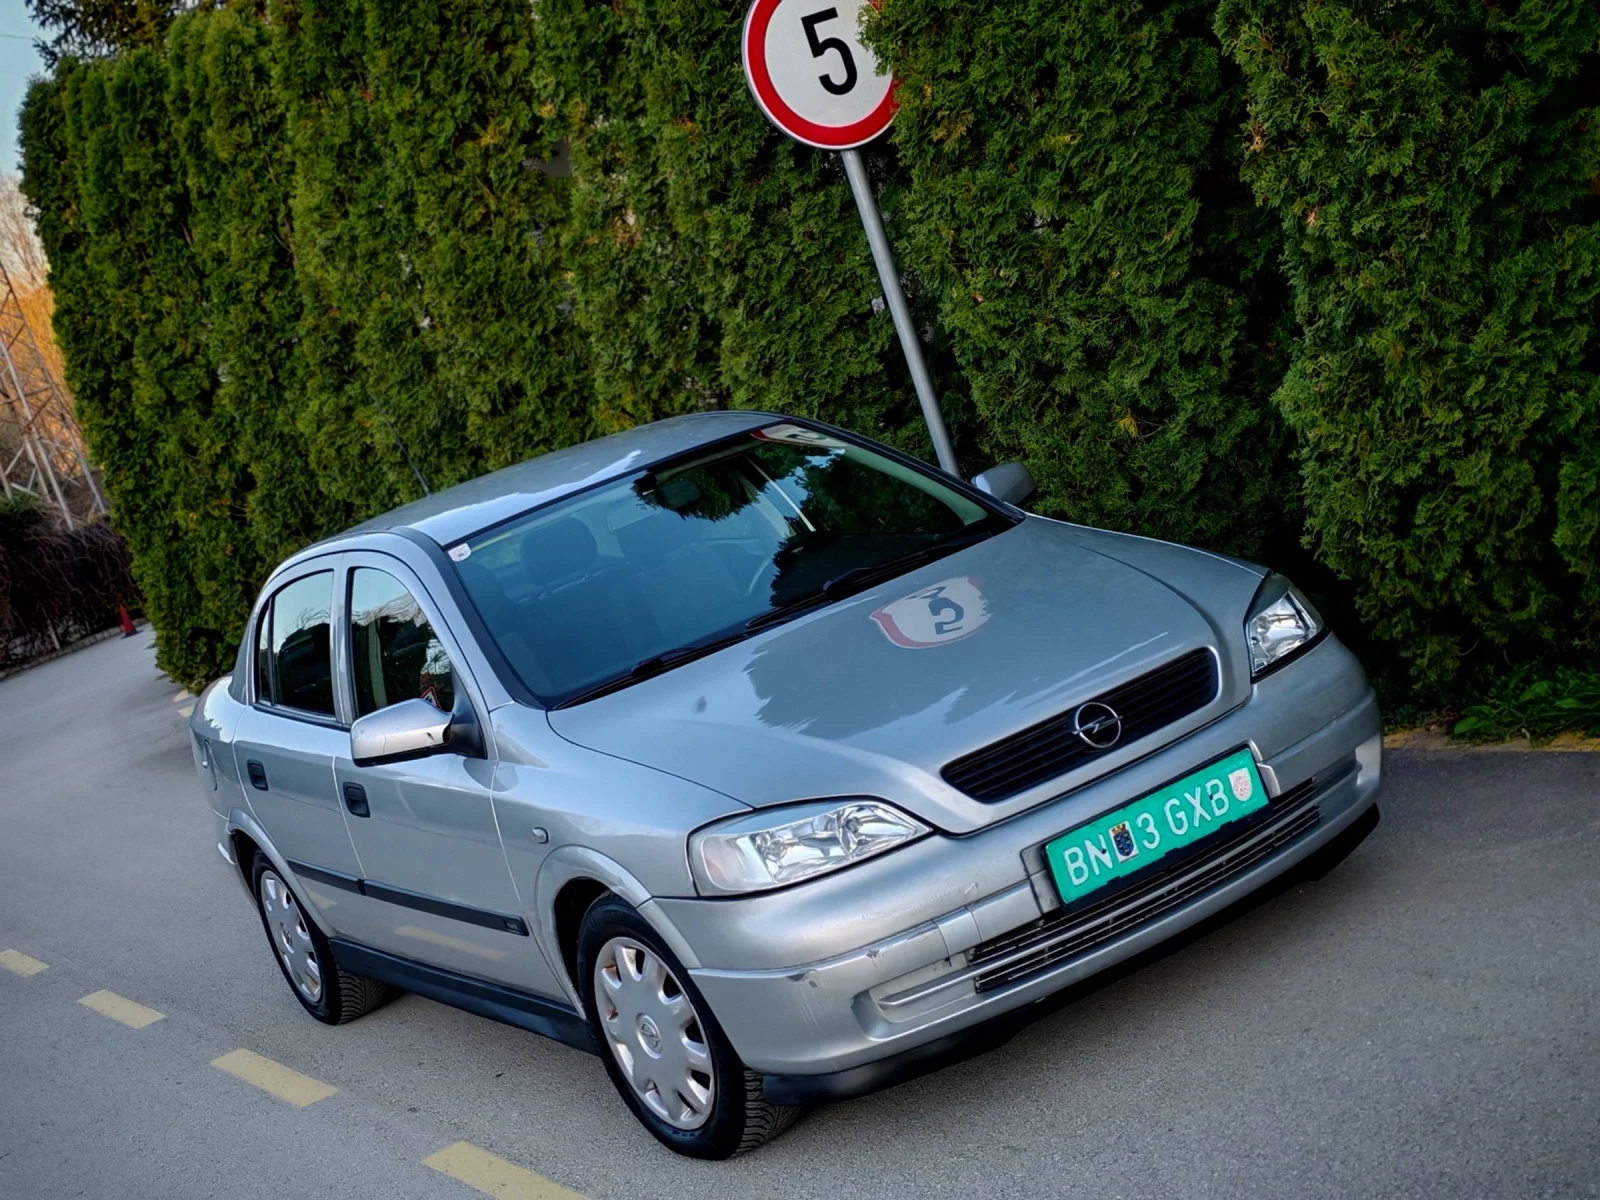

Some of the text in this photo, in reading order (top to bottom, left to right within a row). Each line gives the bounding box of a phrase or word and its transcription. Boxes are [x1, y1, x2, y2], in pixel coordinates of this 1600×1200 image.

[801, 7, 857, 95] 5
[1063, 778, 1229, 886] BN 3 GXB
